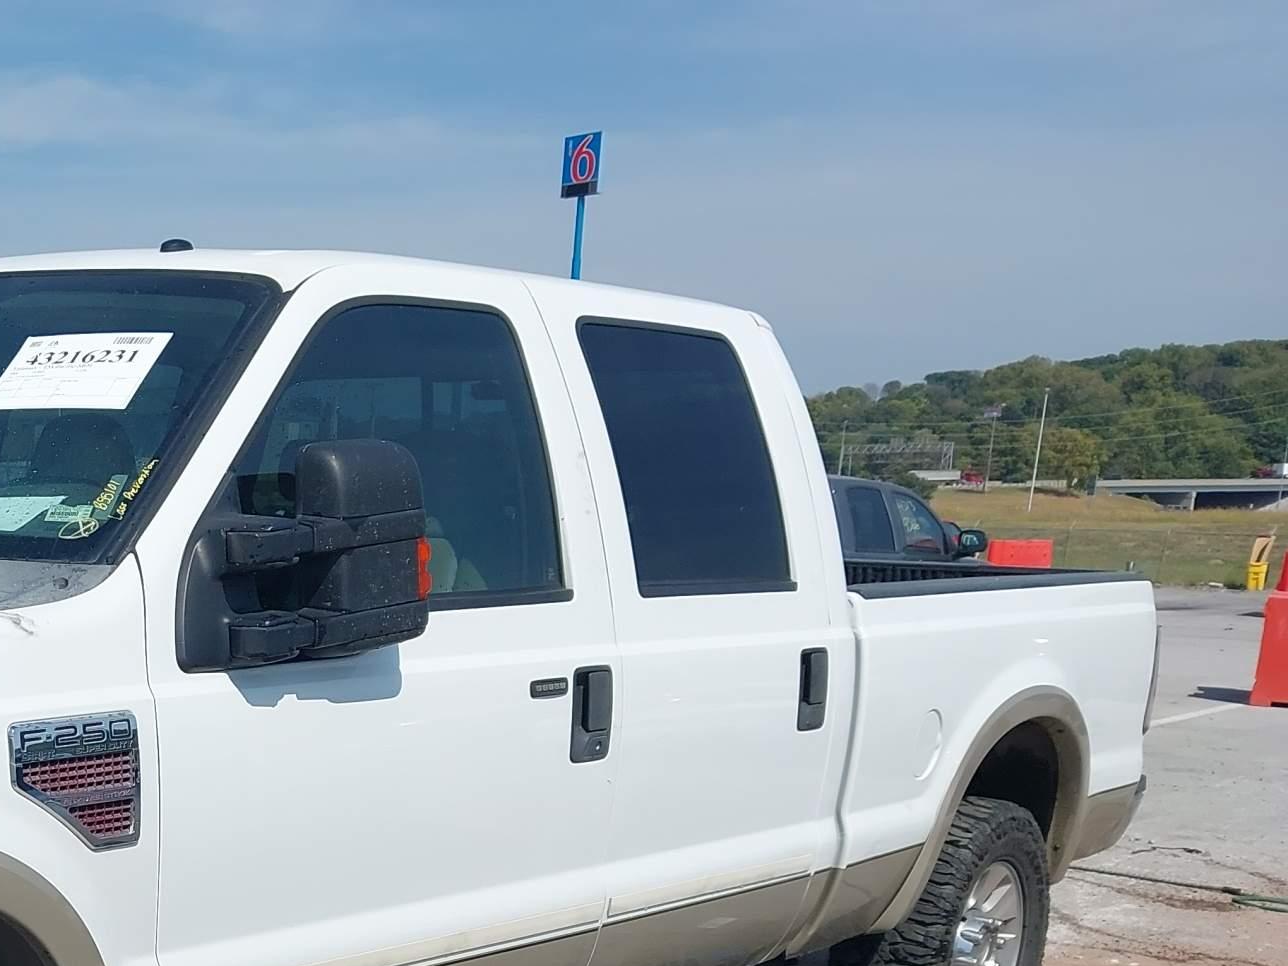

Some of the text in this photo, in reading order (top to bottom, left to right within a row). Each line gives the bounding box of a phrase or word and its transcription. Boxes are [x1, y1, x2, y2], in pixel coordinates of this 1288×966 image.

[571, 134, 596, 183] 6
[26, 349, 140, 366] 43216231
[20, 718, 133, 752] F-250
